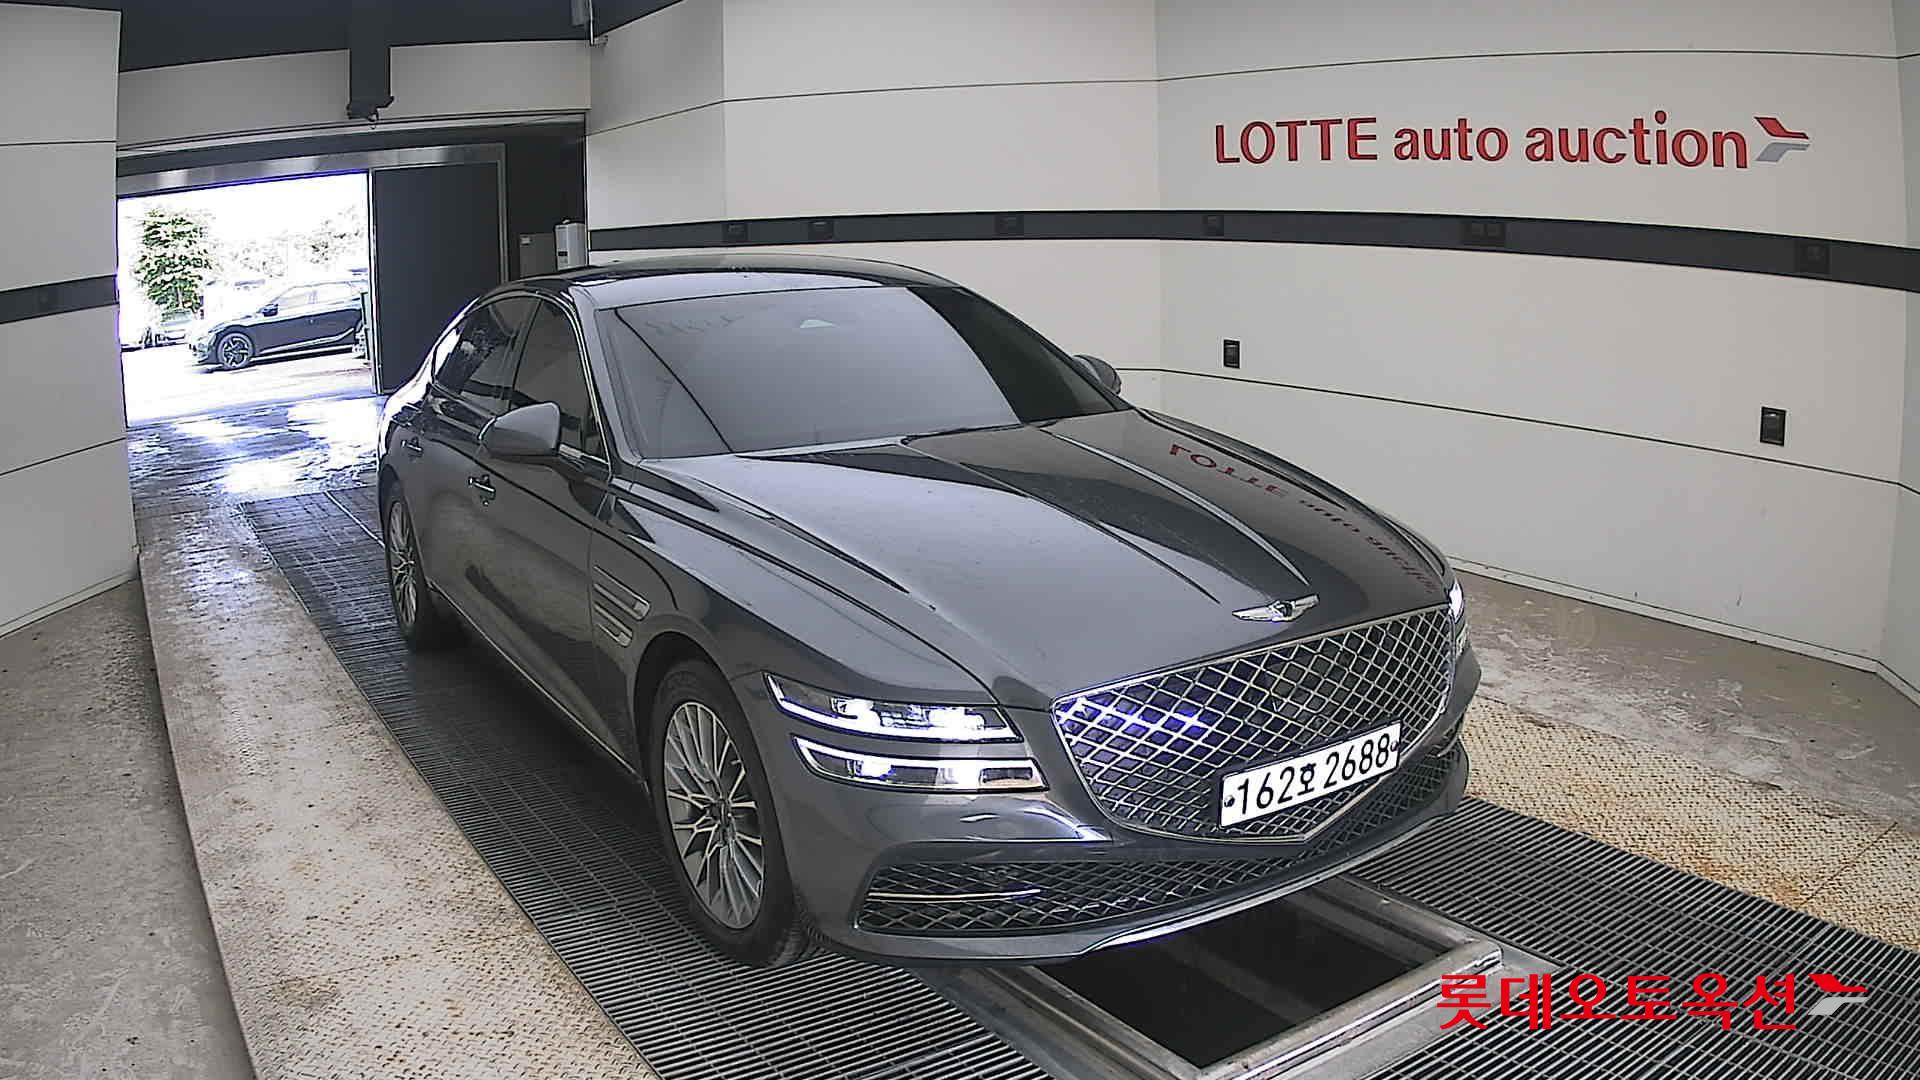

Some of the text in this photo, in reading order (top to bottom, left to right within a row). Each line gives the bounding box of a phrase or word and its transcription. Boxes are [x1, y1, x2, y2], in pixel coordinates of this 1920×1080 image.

[1215, 110, 1748, 168] LOTTE auto auction
[1323, 733, 1391, 789] 2688
